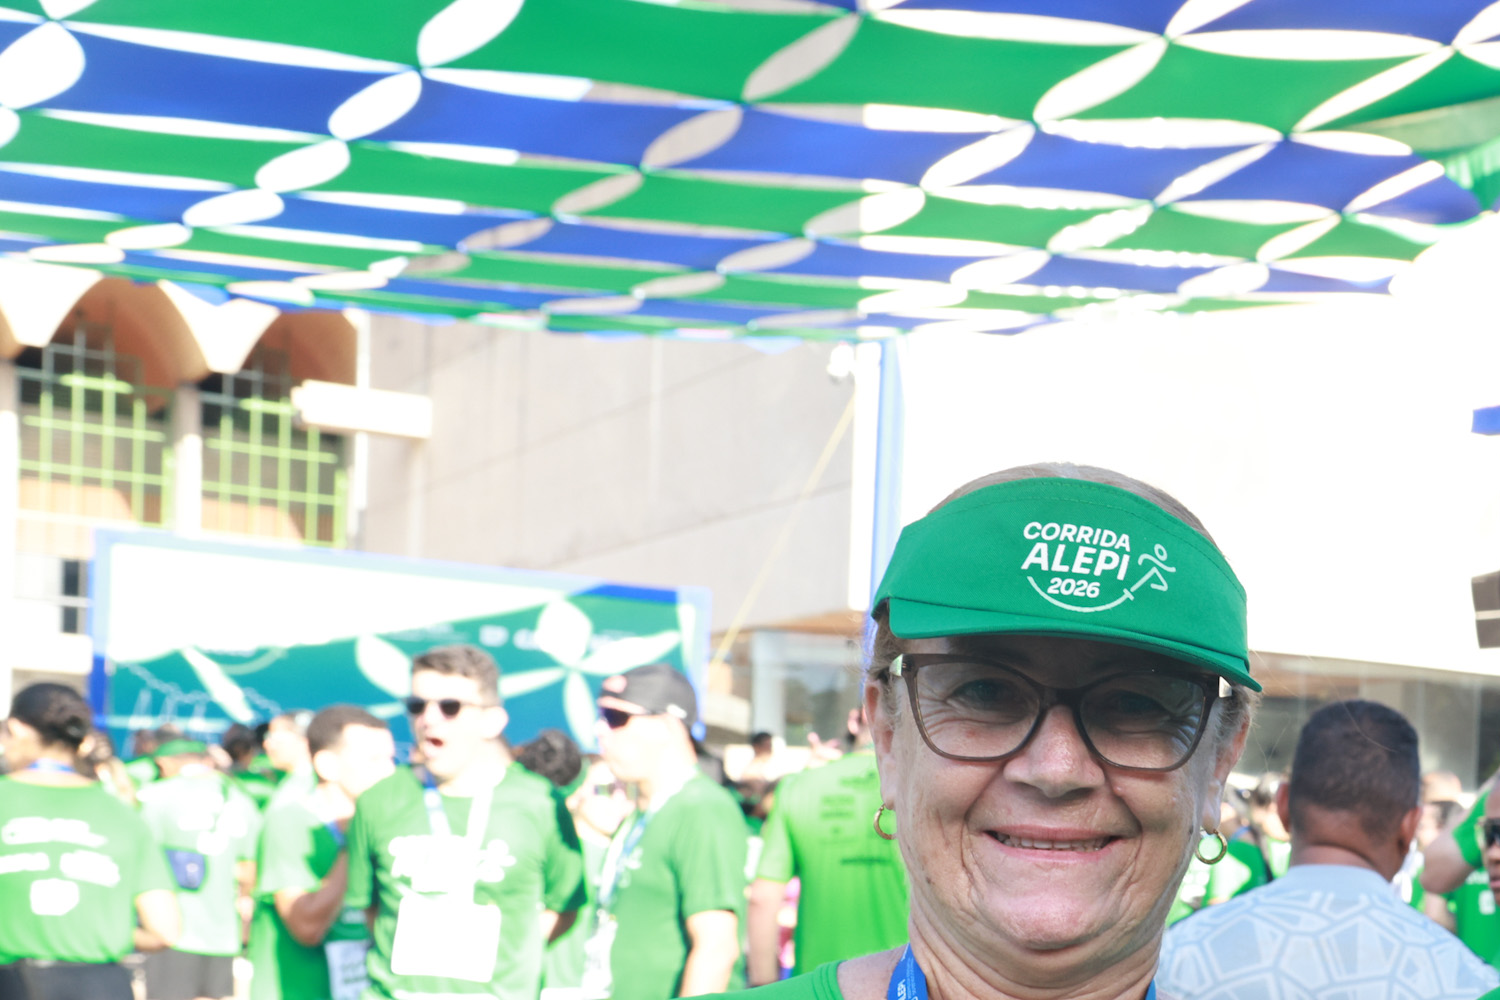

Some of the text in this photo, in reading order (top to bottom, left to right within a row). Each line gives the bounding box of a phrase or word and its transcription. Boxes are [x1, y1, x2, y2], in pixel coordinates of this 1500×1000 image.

[1023, 521, 1131, 552] CORRIDA
[1021, 542, 1130, 581] ALEPI
[1047, 577, 1100, 598] 2026
